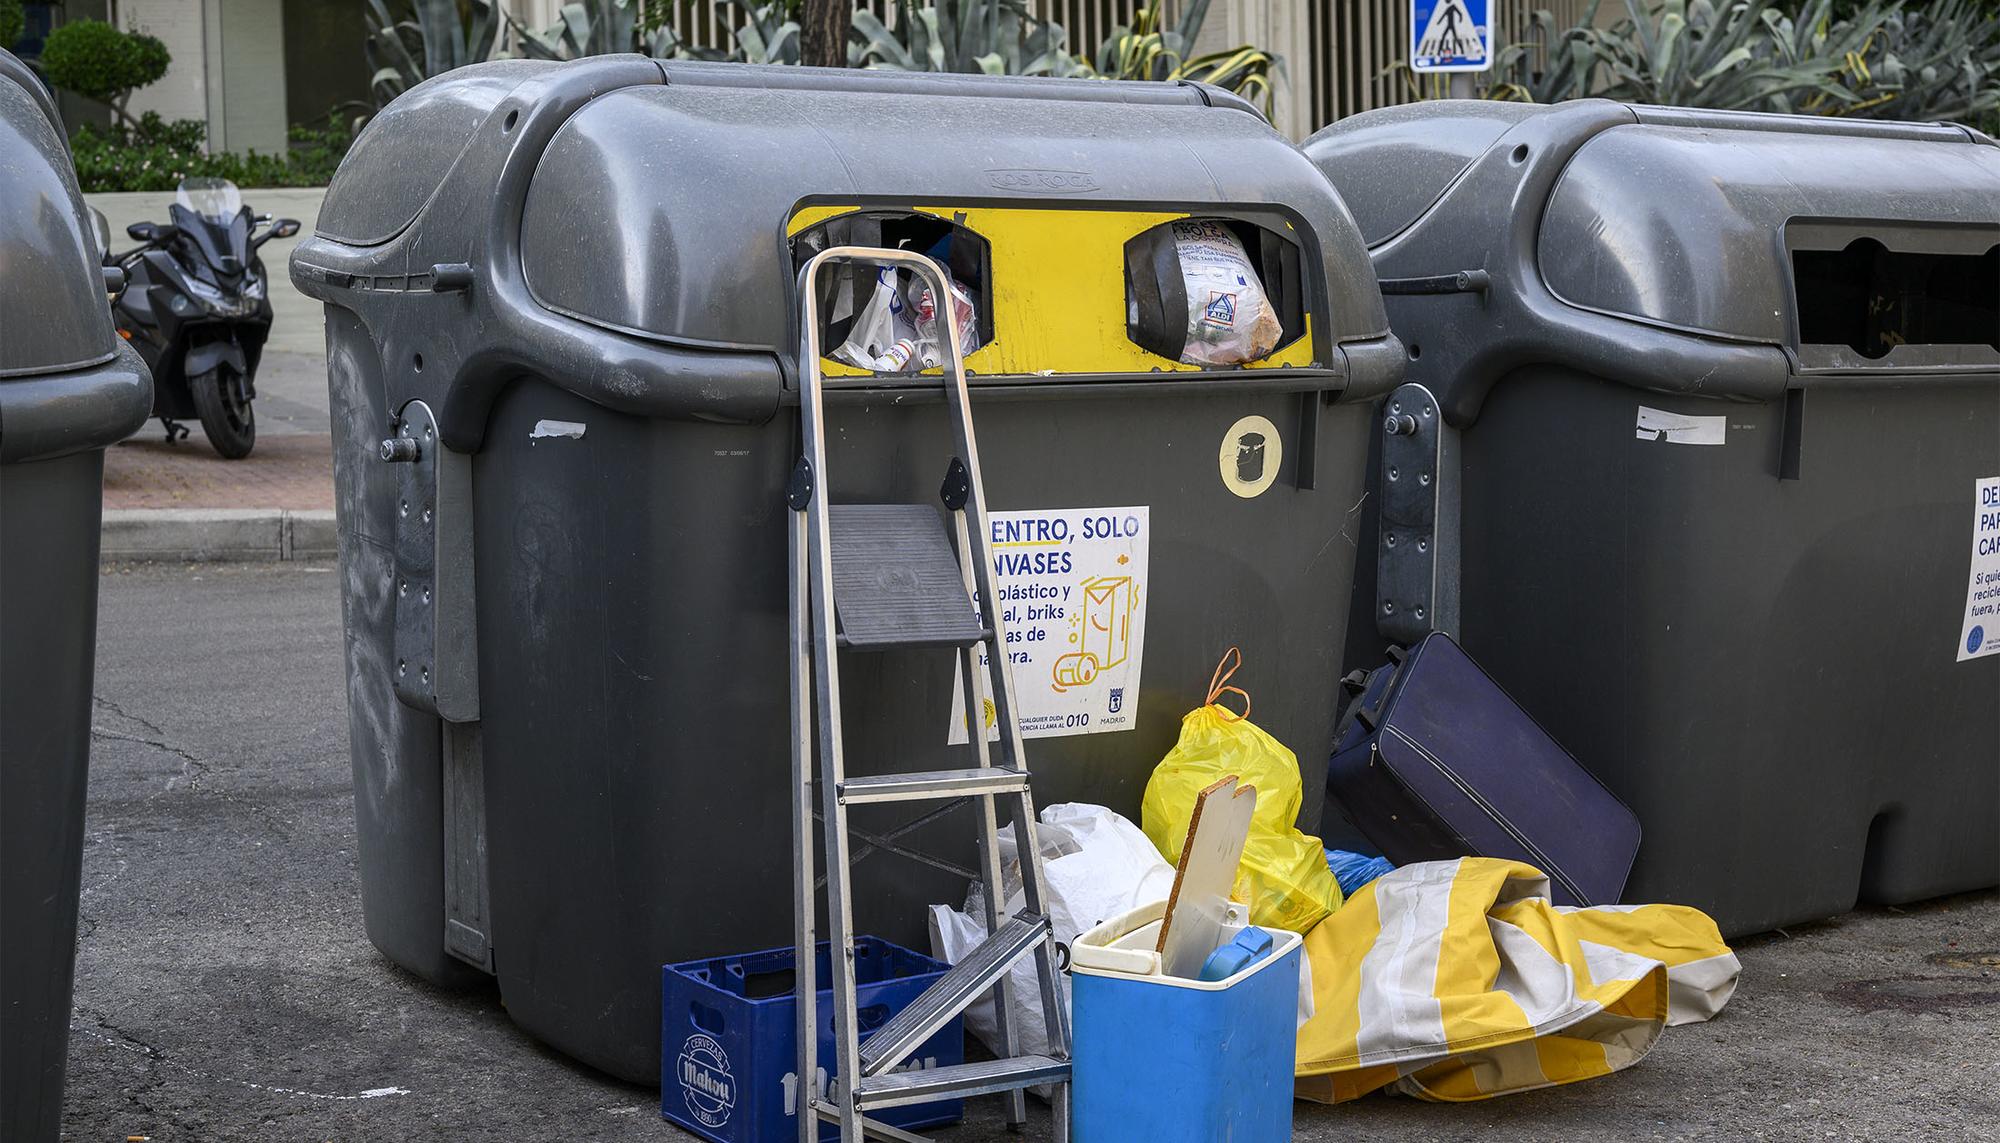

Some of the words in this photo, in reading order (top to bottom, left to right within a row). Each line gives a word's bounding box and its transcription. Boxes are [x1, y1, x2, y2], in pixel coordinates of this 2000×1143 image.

[1210, 311, 1230, 321] ALDI
[992, 518, 1075, 545] ENTRO,
[1082, 516, 1139, 540] SOLO
[993, 551, 1072, 577] NVASES
[1975, 572, 1984, 585] Si
[1062, 586, 1071, 601] y
[1028, 604, 1064, 620] briks
[1971, 603, 1995, 617] fuera,
[1026, 626, 1046, 641] de
[1066, 713, 1089, 728] 010
[1100, 716, 1126, 725] MADRID
[691, 1037, 723, 1061] CERVEZAS
[683, 1060, 730, 1101] Mahou
